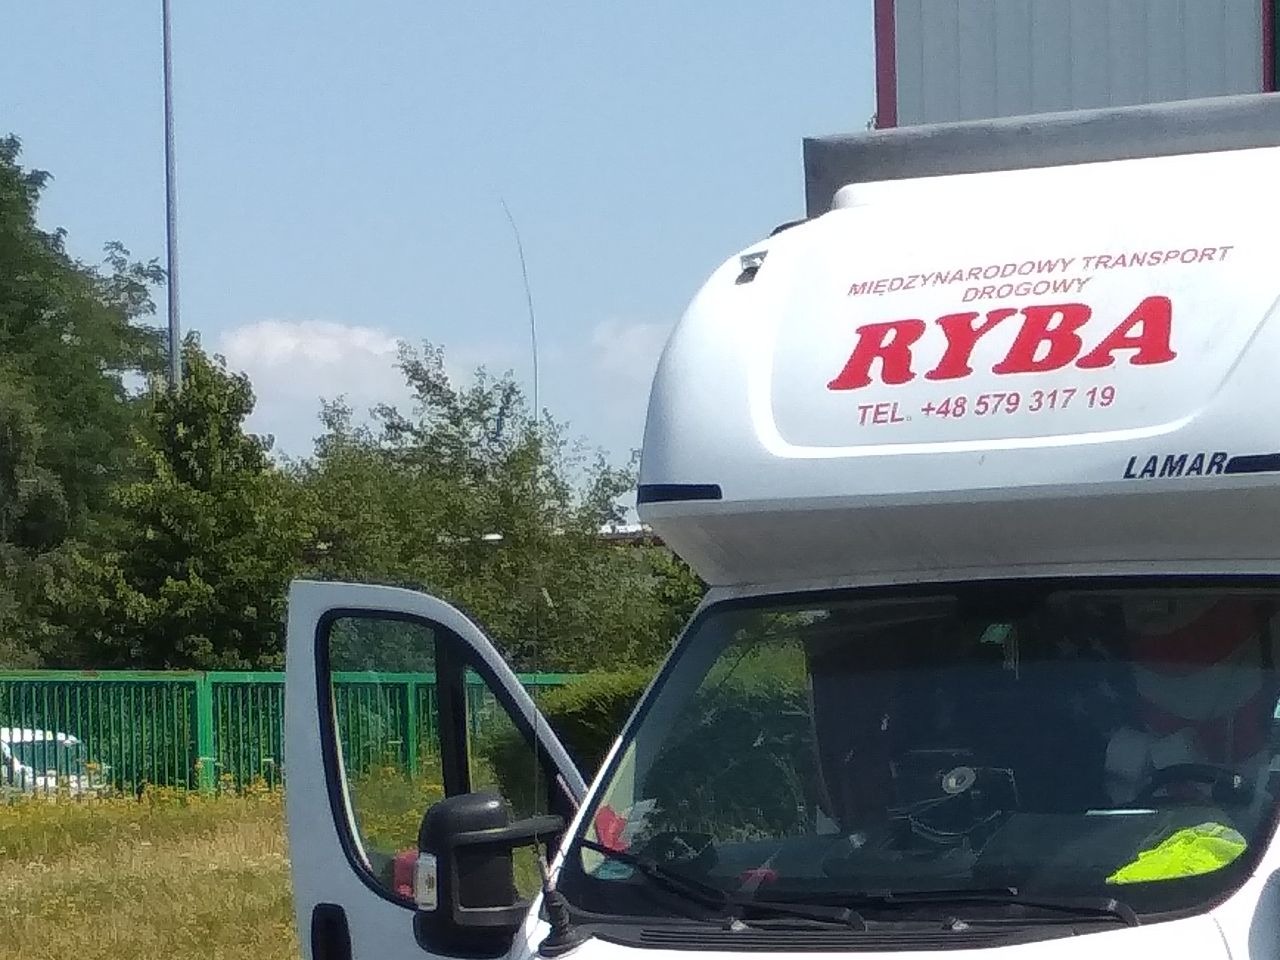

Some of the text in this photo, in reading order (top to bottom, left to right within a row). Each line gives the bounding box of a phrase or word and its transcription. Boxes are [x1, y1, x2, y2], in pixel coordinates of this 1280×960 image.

[1082, 246, 1234, 271] TRANSPORT
[961, 276, 1093, 303] DROGOWY
[826, 296, 1178, 391] RYBA
[857, 385, 1116, 427] TEL. +48 579 317 19
[1123, 452, 1229, 480] LAMAR
